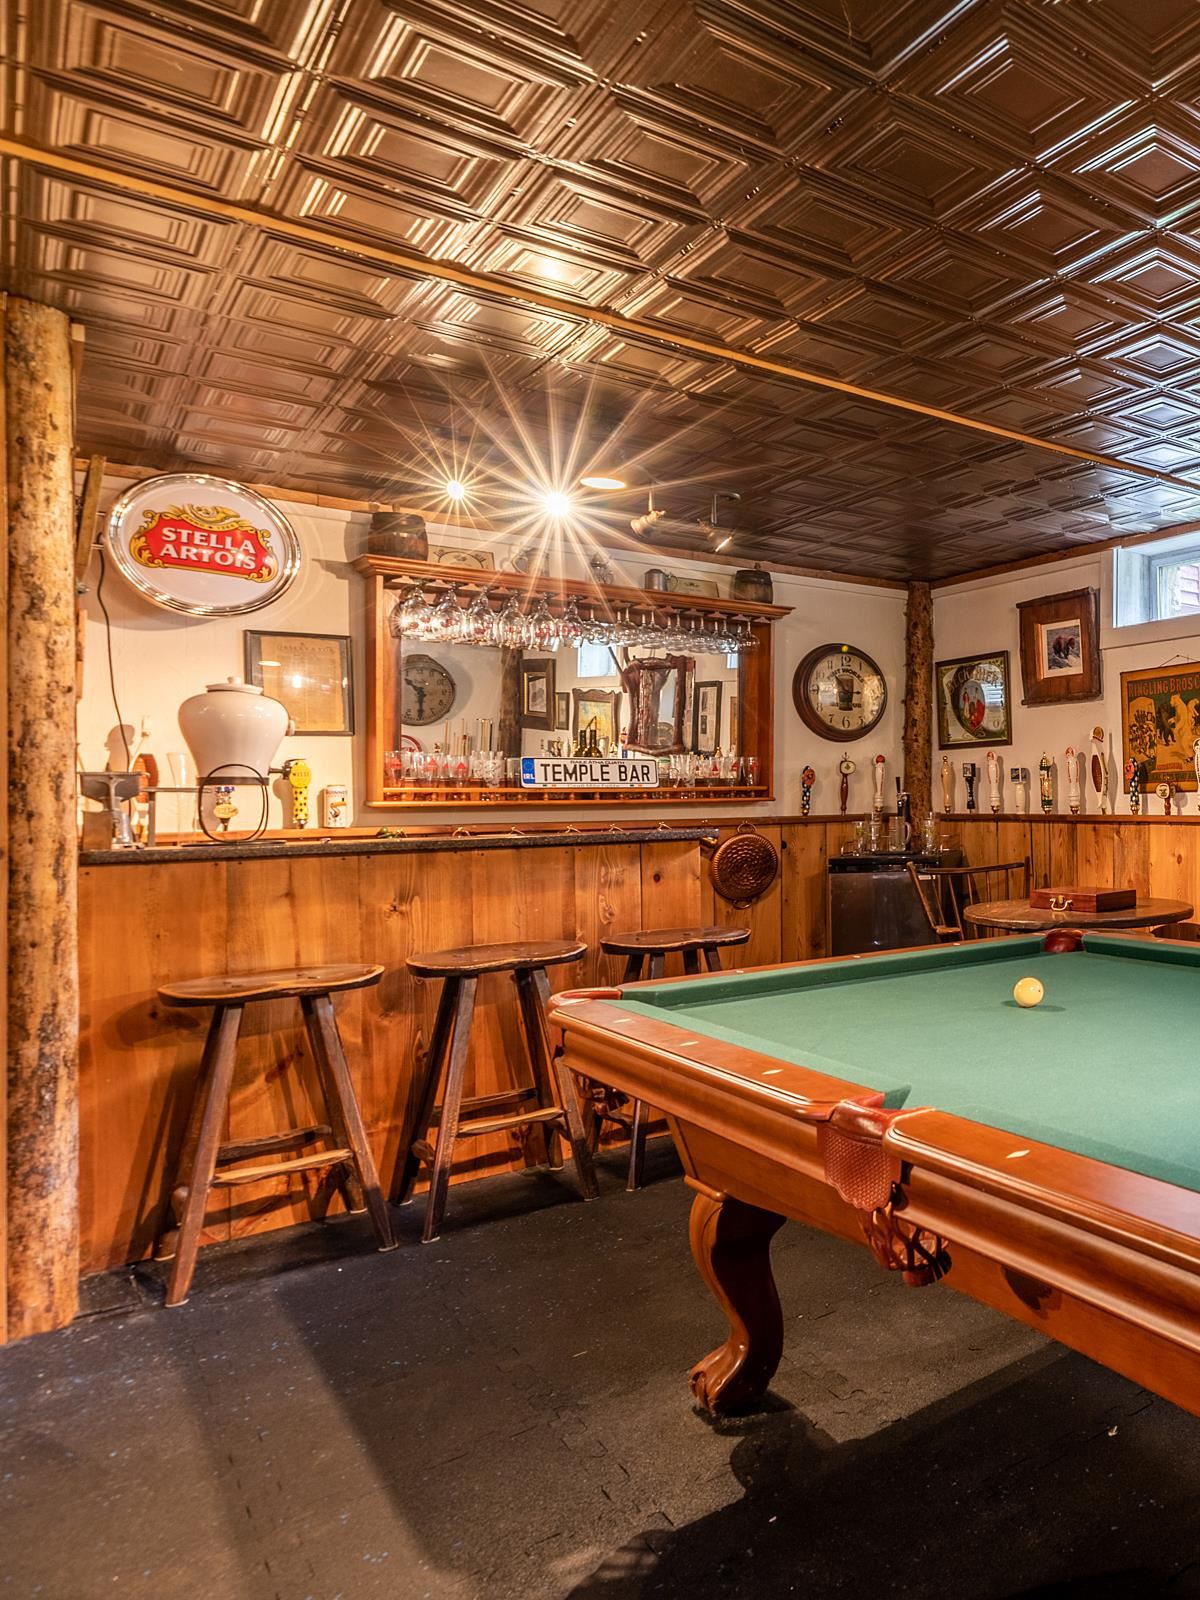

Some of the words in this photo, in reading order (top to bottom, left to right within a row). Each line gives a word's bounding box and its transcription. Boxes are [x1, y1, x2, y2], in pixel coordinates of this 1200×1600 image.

[161, 527, 256, 554] STELLA
[159, 543, 256, 570] ARTOIS
[1128, 680, 1169, 697] RINGLING
[1169, 676, 1193, 693] BROS
[540, 763, 610, 782] TEMPLE
[618, 764, 650, 782] BAR
